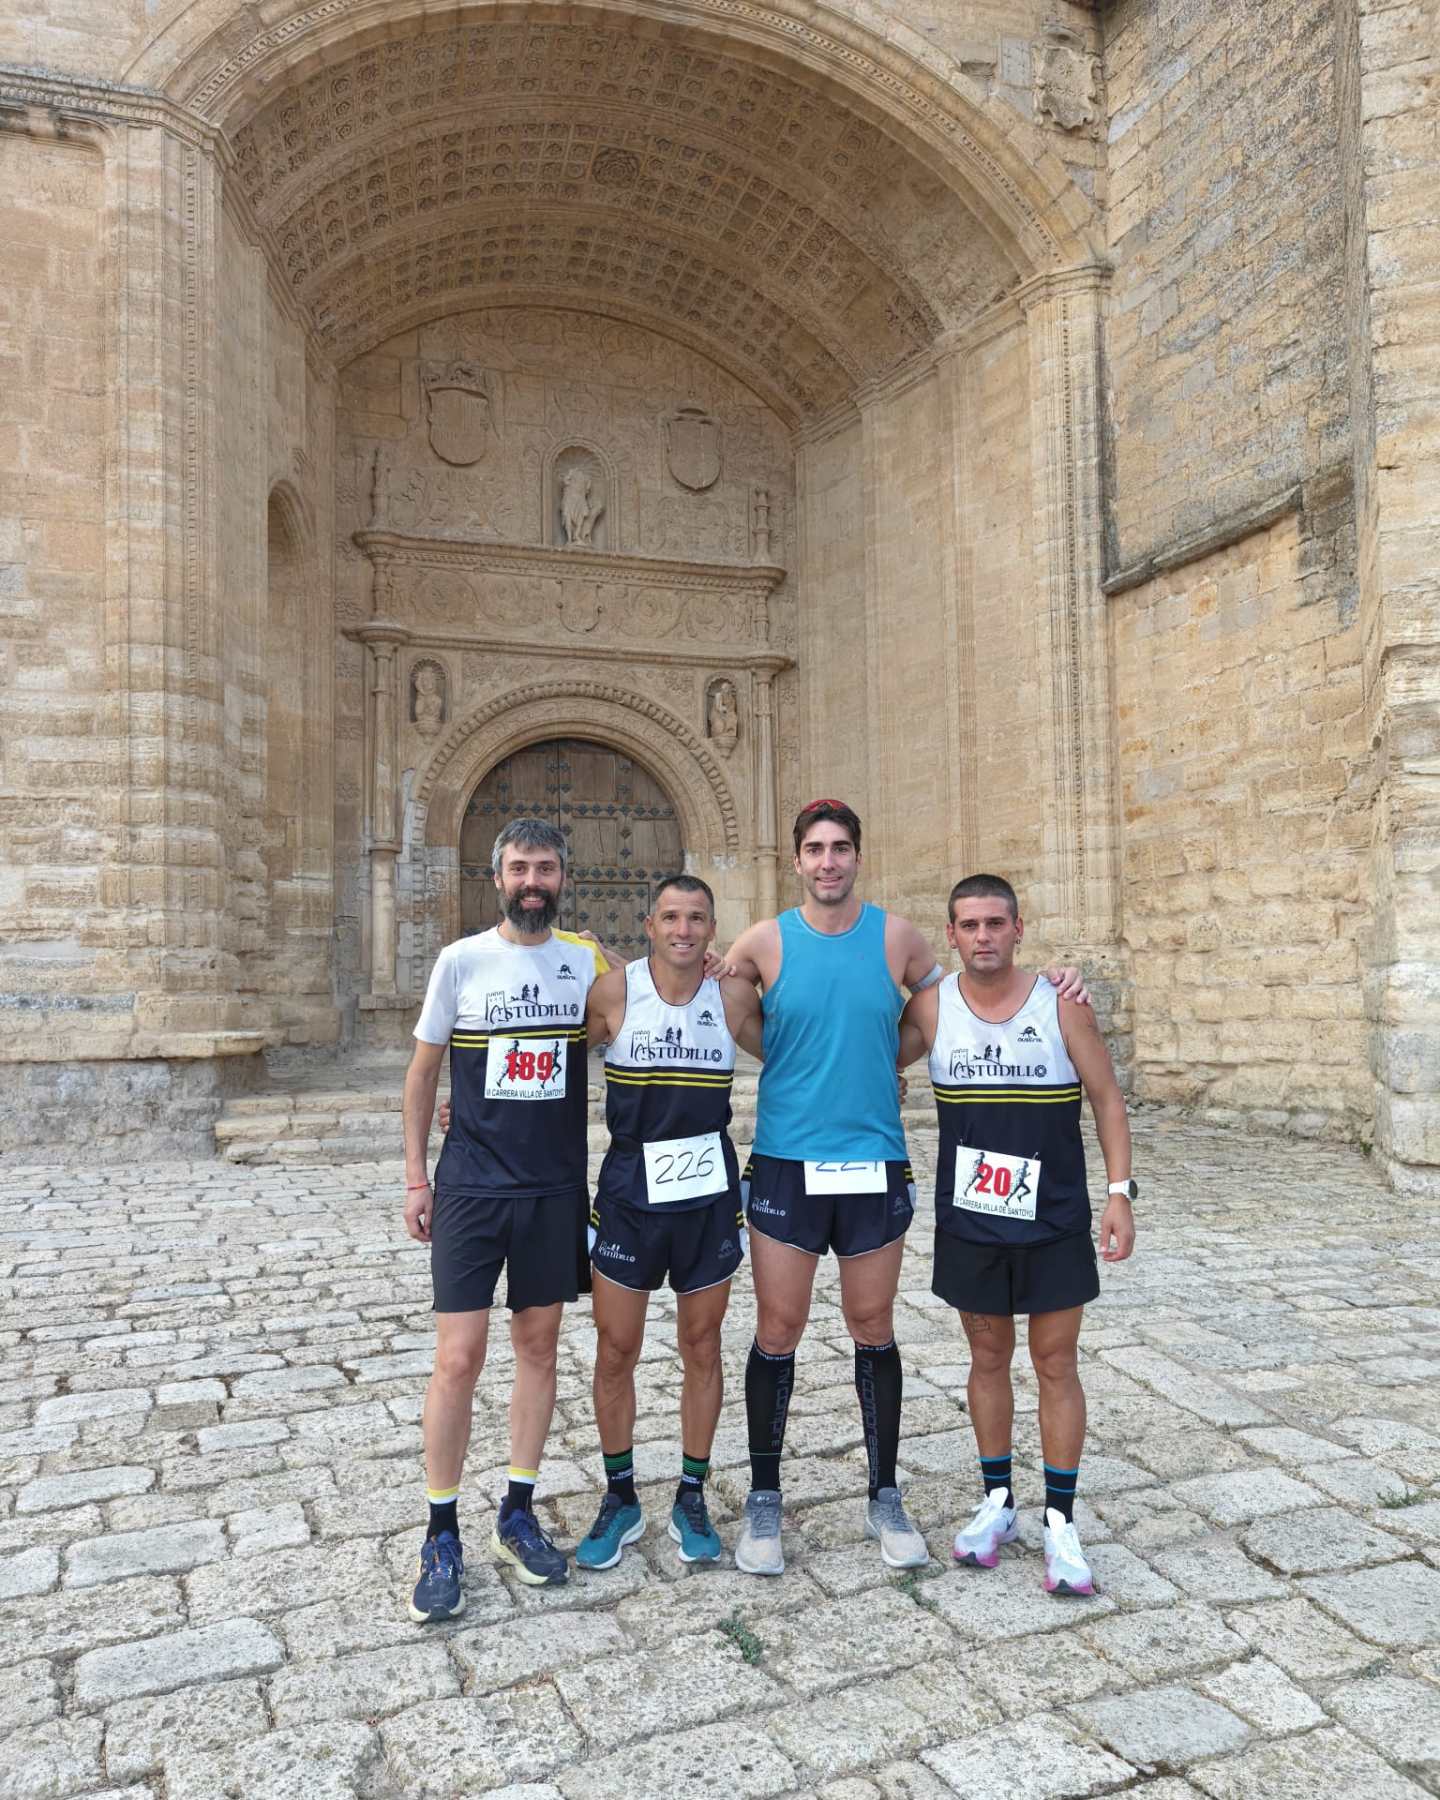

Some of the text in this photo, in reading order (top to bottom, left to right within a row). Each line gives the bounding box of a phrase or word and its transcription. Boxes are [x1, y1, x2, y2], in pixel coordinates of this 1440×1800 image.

[505, 1051, 553, 1081] 189
[491, 1088, 518, 1097] CARRERA
[519, 1089, 535, 1098] VILLA
[535, 1090, 543, 1098] DE
[655, 1147, 715, 1185] 226
[976, 1163, 1012, 1197] 20
[959, 1198, 982, 1209] CARRERA
[982, 1203, 998, 1212] VILLA
[999, 1205, 1007, 1214] DE
[1007, 1207, 1034, 1218] SANTOYO
